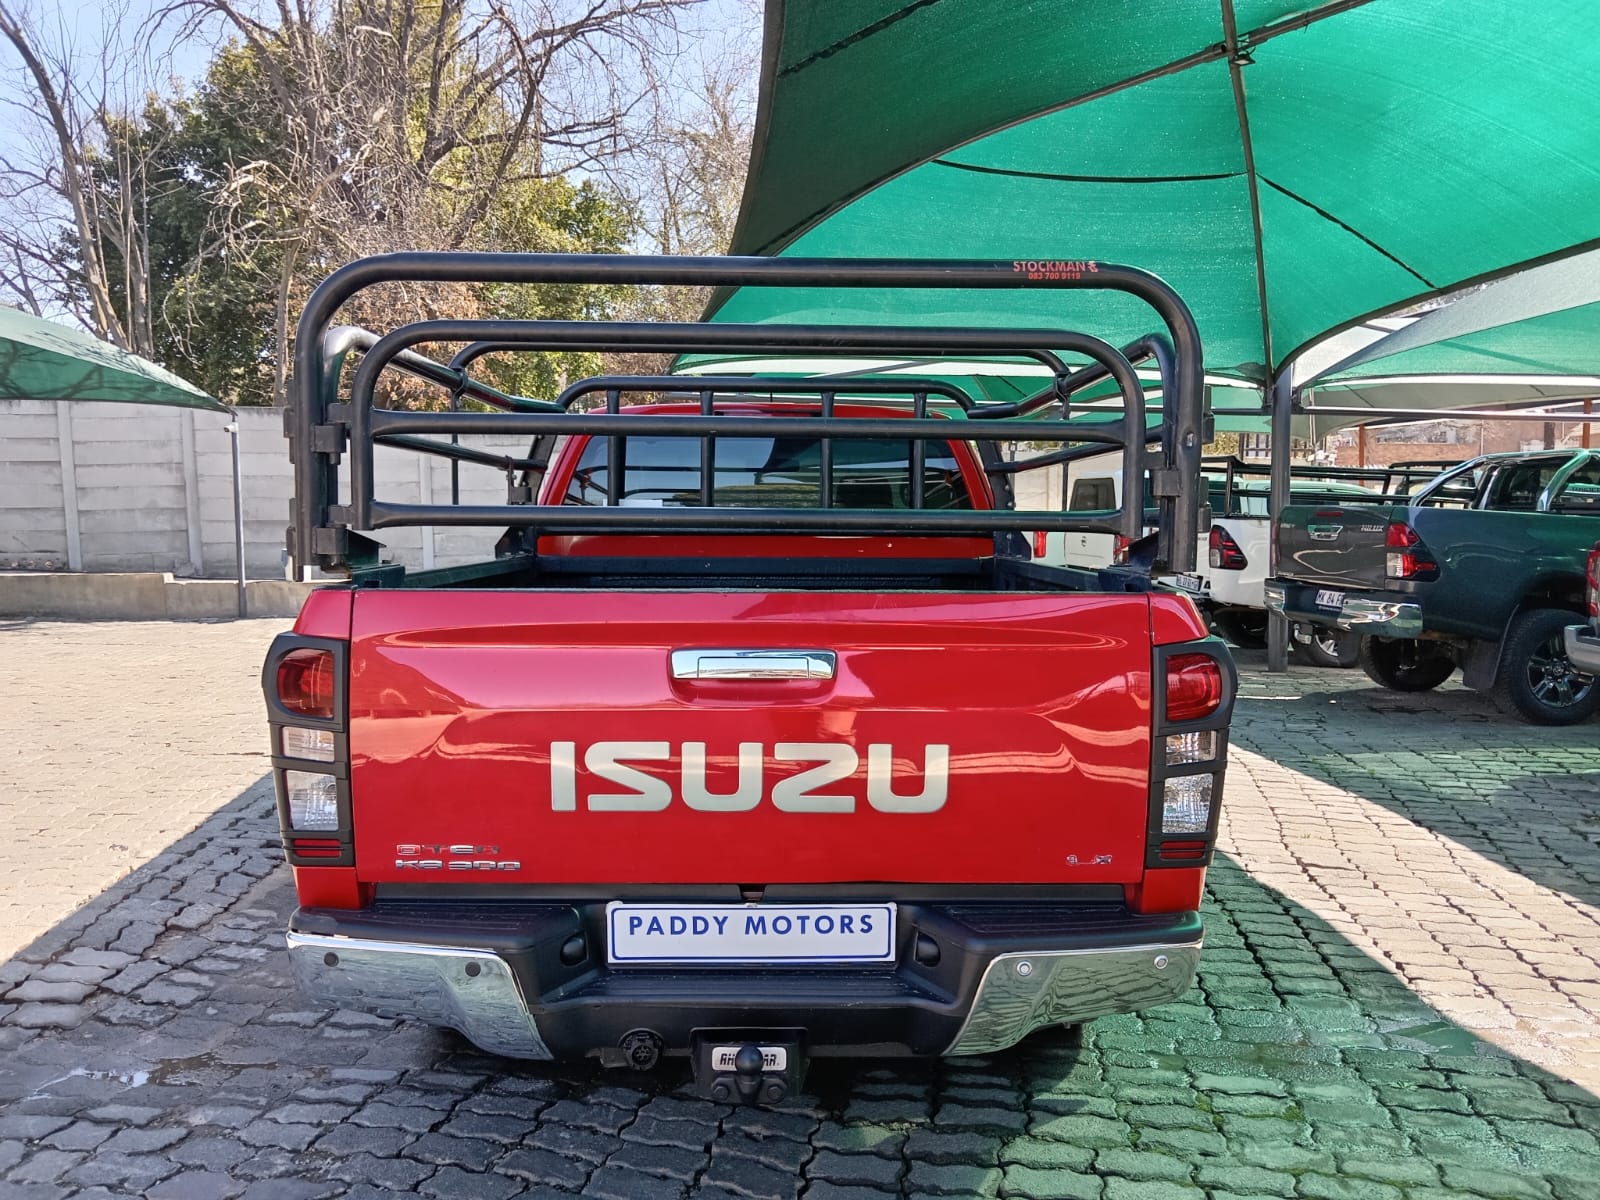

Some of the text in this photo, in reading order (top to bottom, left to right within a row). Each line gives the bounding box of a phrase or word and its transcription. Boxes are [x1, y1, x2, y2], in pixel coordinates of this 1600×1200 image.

[1013, 261, 1086, 272] STOCKMAN
[1045, 272, 1059, 280] 700
[550, 741, 950, 813] ISUZU
[629, 914, 874, 936] PADDY MOTORS
